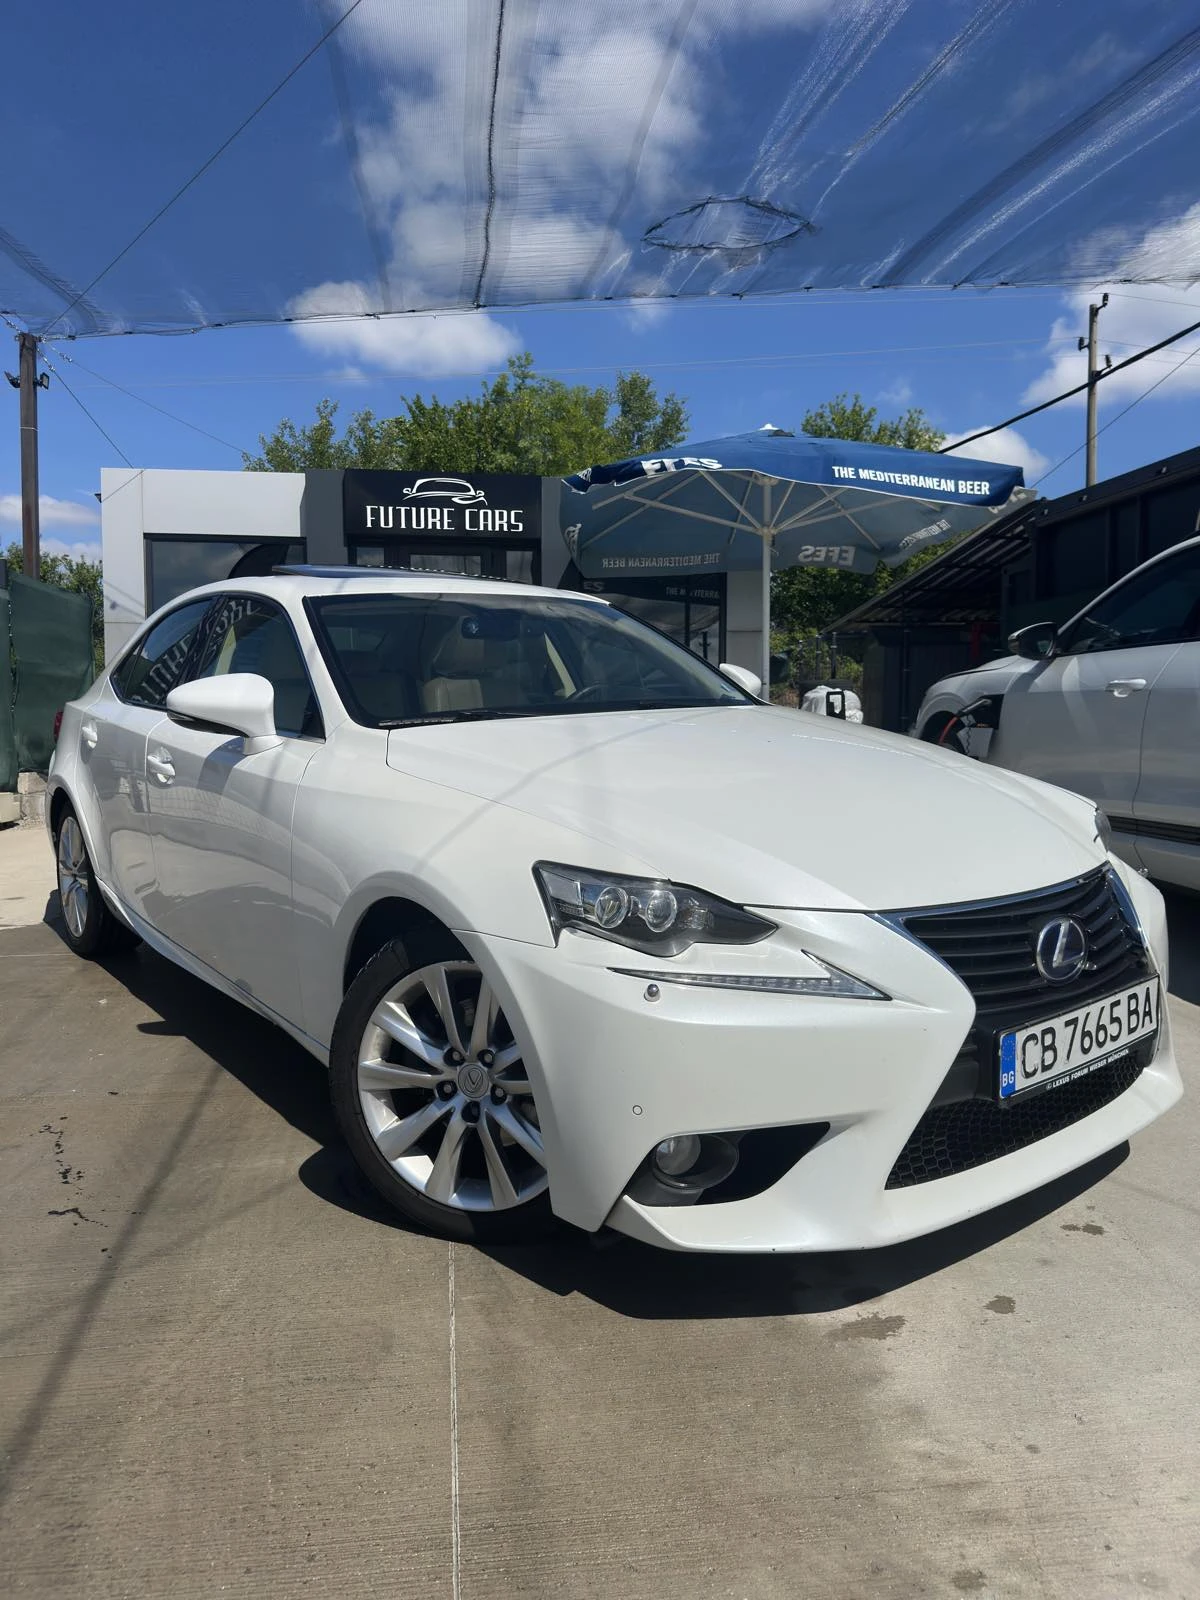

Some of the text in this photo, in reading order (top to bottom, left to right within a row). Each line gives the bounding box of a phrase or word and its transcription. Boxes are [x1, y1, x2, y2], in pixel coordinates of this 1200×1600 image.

[832, 466, 990, 495] THE MEDITERRANEAN BEER
[365, 505, 524, 532] FUTURE CARS
[1021, 986, 1153, 1079] CB 7665 BA
[1002, 1070, 1015, 1087] BG
[1052, 1075, 1070, 1088] LEXUS
[1071, 1066, 1089, 1080] FORUM
